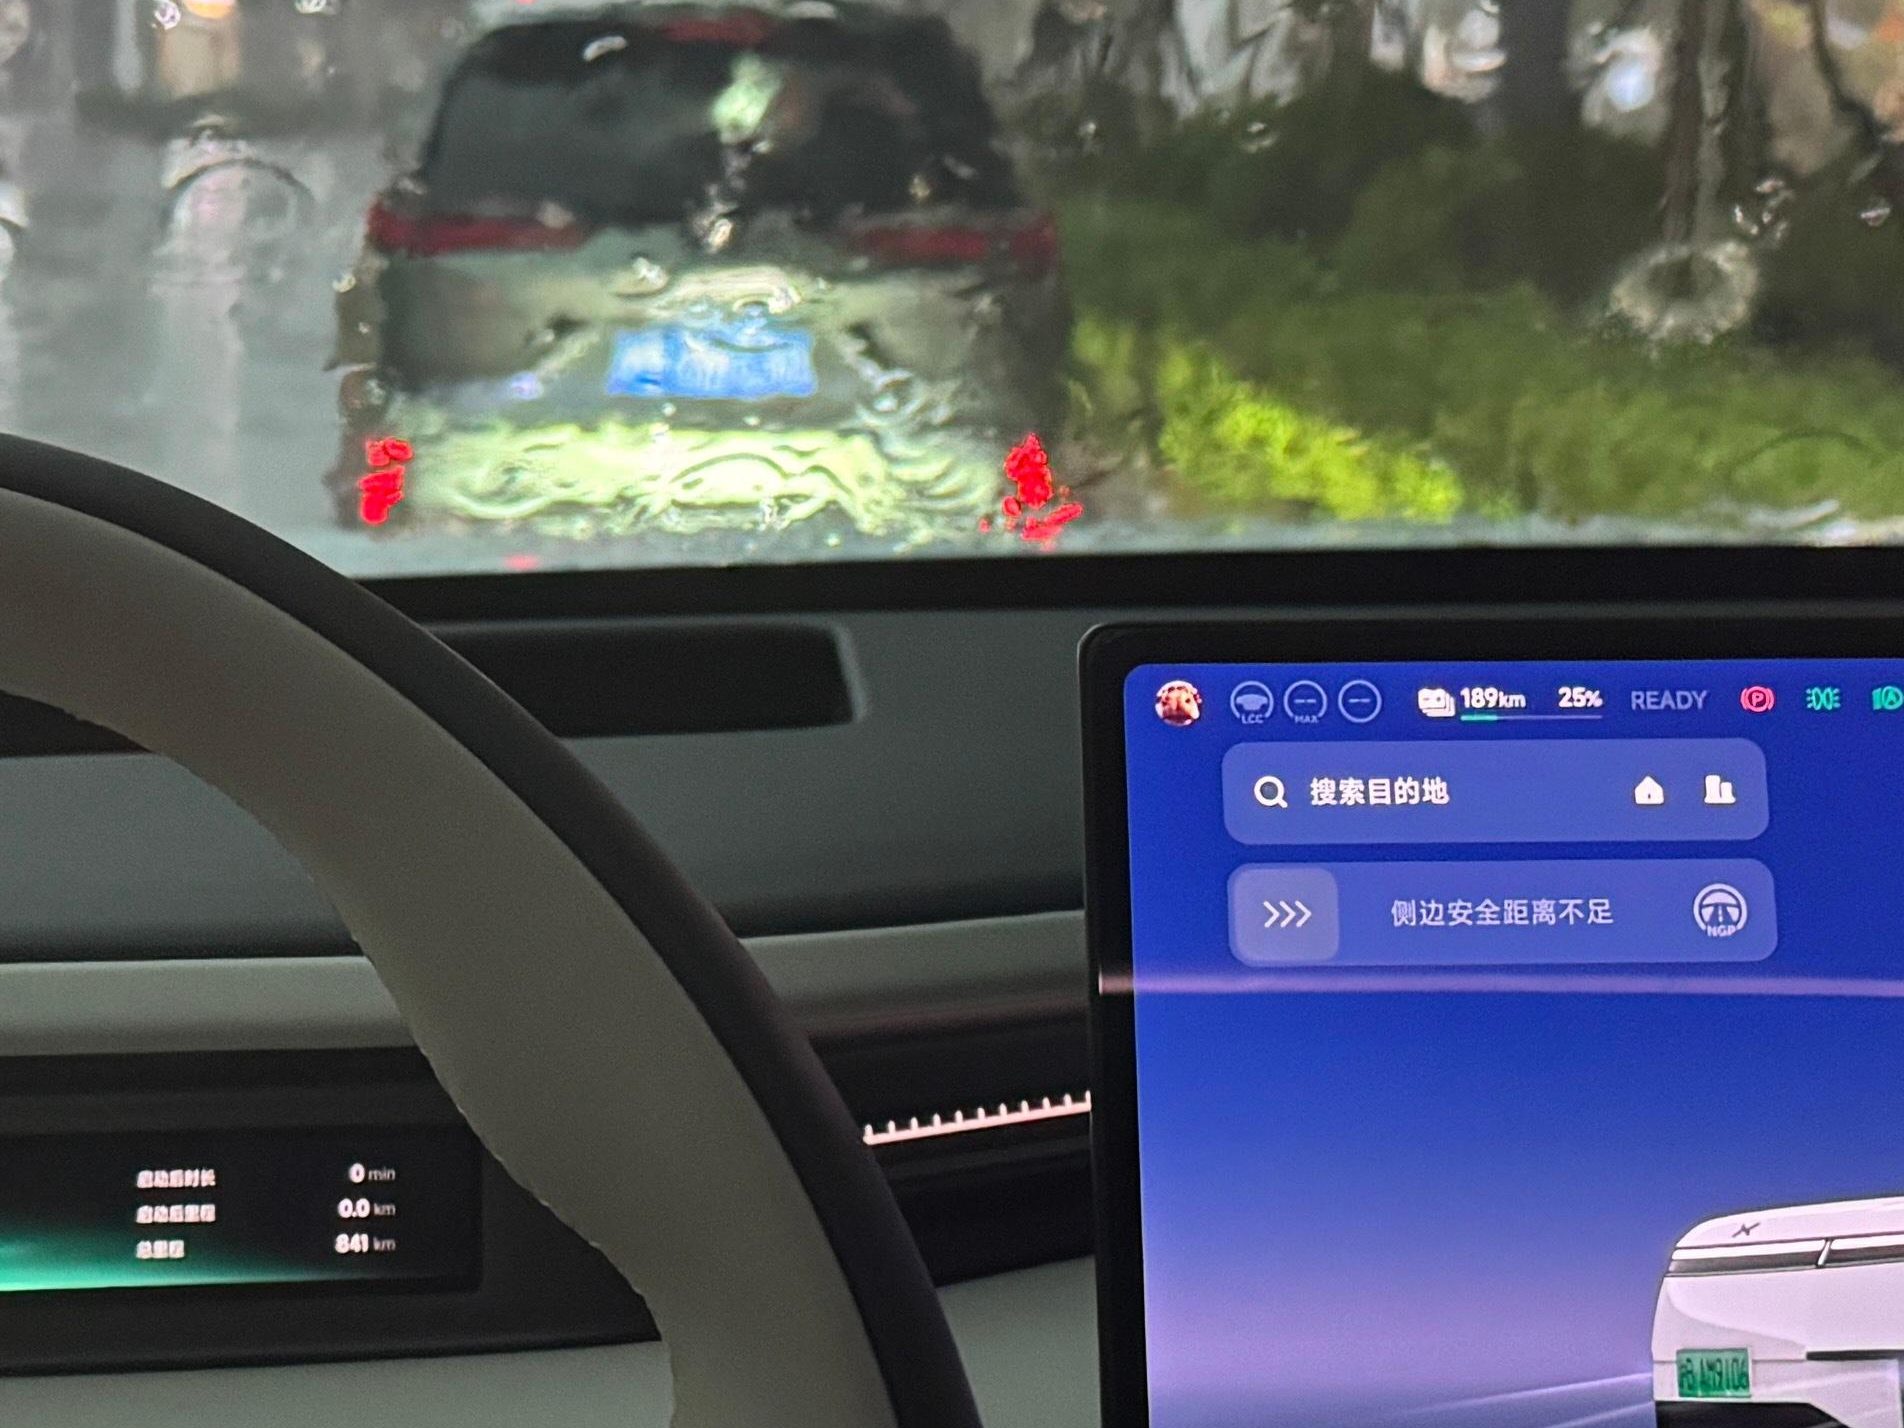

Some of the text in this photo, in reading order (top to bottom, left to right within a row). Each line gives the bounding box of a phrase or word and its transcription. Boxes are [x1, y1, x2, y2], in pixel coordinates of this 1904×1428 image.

[1460, 686, 1603, 709] 189km 25%
[1631, 690, 1707, 710] READY
[1309, 776, 1450, 807] 搜索目的地
[1391, 898, 1614, 928] 侧边安全距离不足
[1706, 924, 1737, 937] NGP
[349, 1162, 397, 1184] 0 min
[338, 1197, 396, 1218] 0.0 km
[335, 1233, 396, 1254] 841 km
